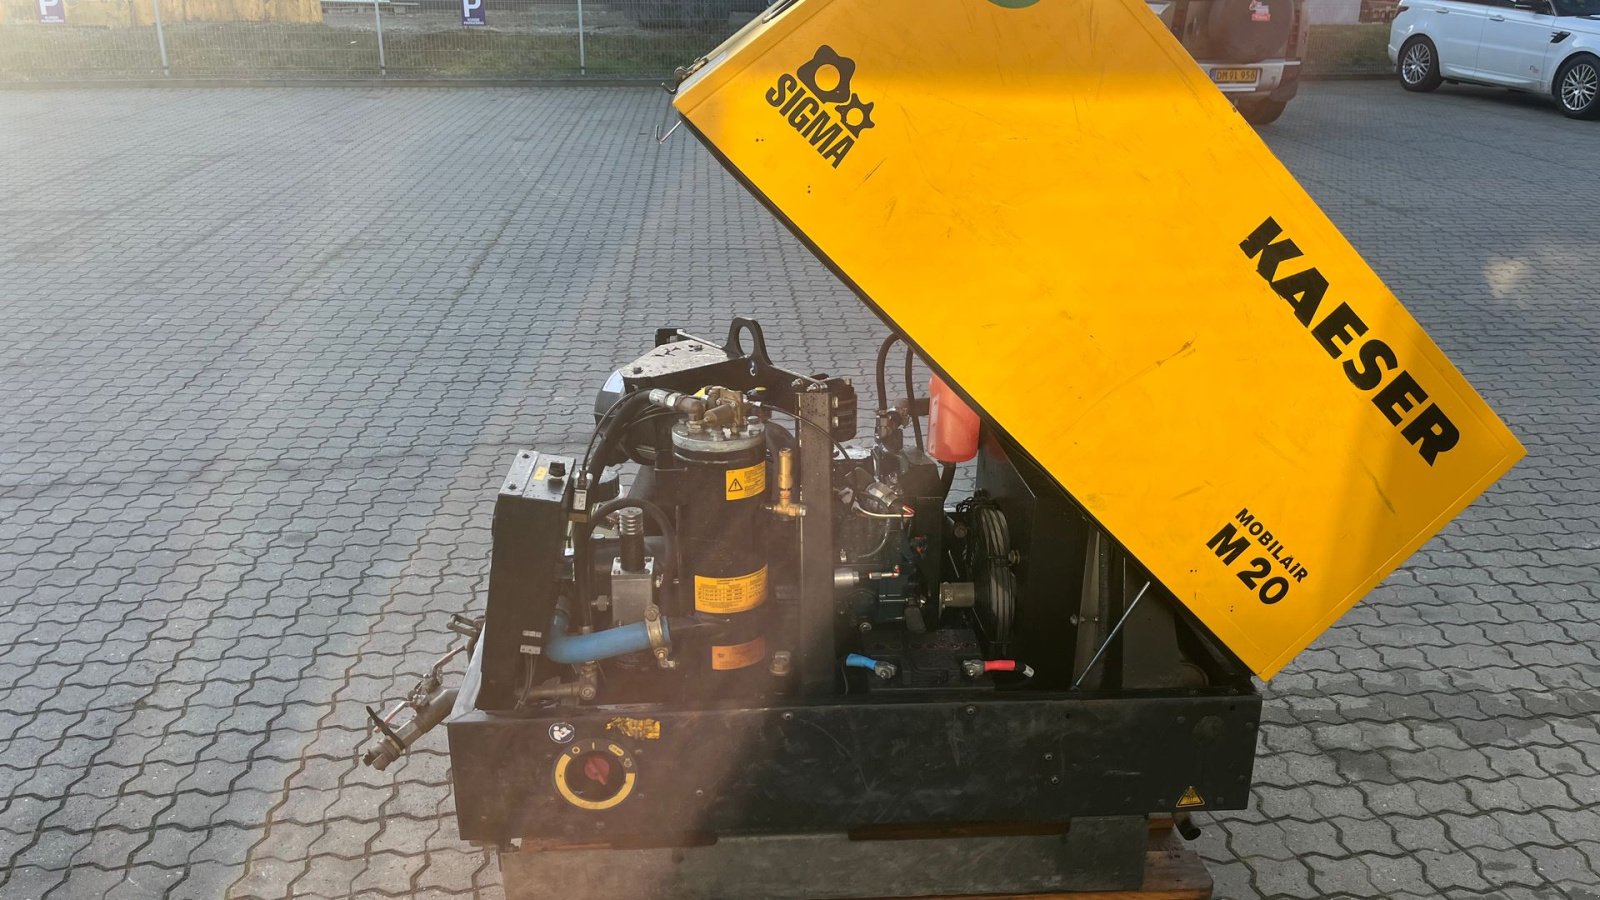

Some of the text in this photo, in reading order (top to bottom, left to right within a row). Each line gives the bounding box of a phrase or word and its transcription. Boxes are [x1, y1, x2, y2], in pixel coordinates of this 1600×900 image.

[463, 0, 481, 17] P
[765, 73, 855, 169] SIGMA
[1239, 216, 1460, 467] KAESER
[1206, 522, 1289, 605] M 20
[1235, 507, 1308, 583] MOBILAIR
